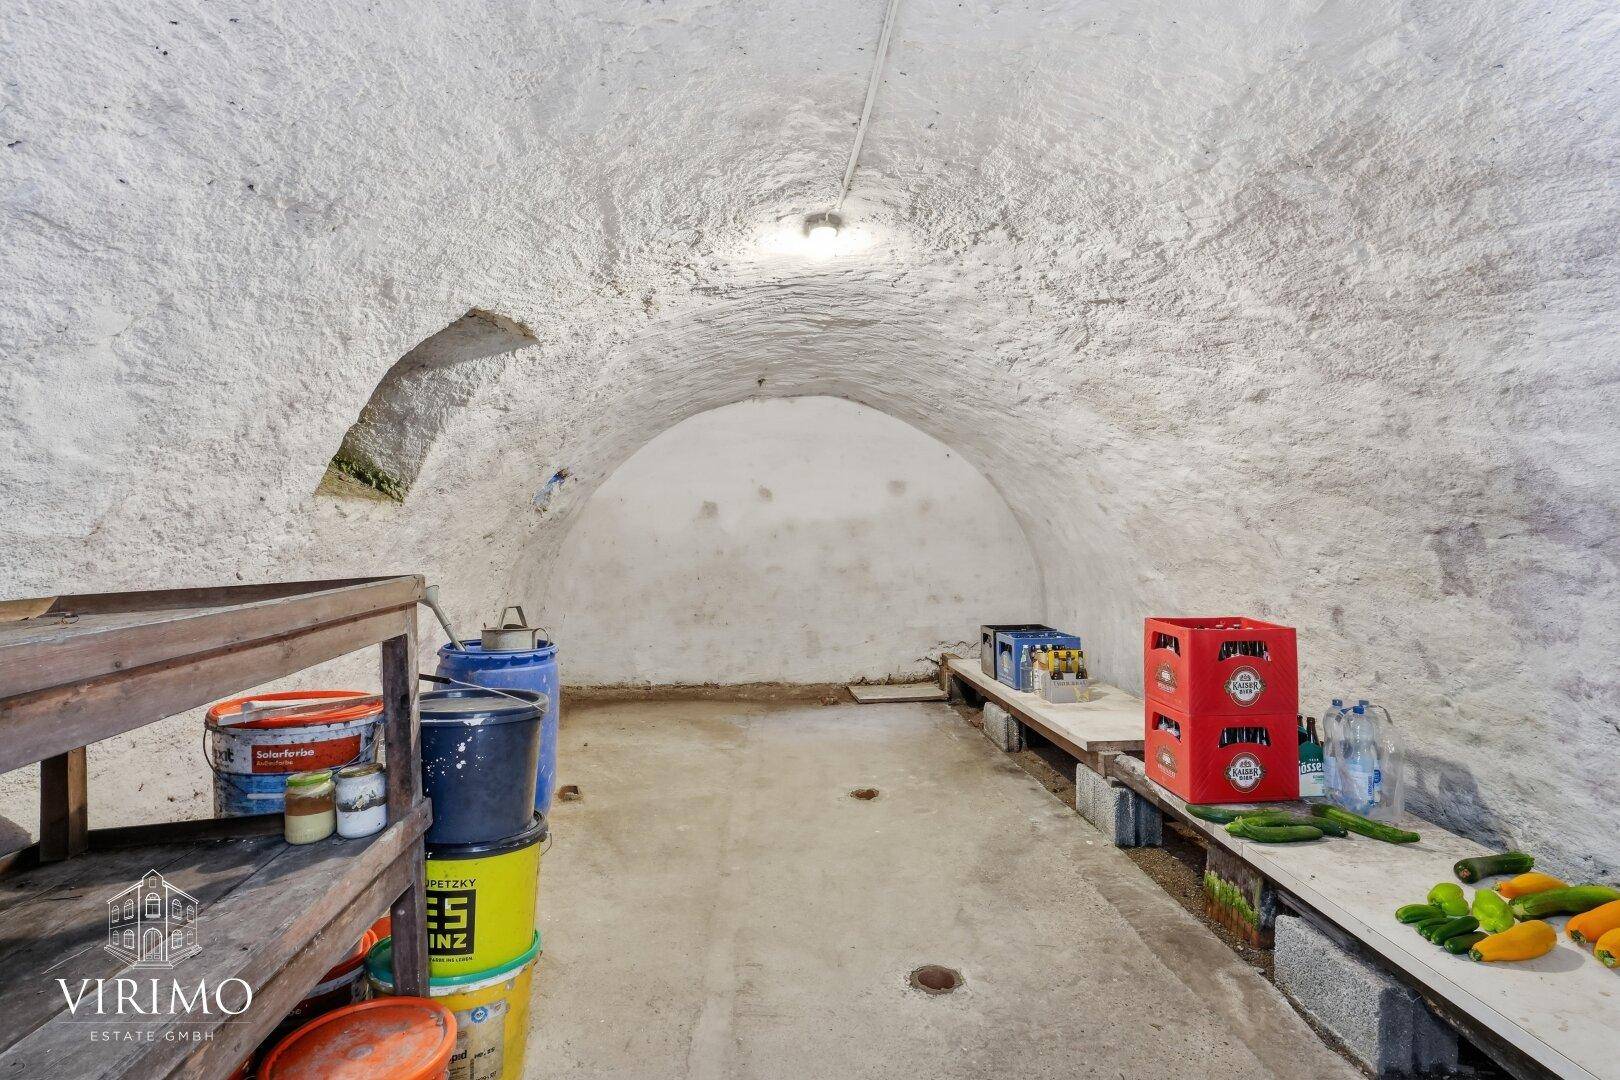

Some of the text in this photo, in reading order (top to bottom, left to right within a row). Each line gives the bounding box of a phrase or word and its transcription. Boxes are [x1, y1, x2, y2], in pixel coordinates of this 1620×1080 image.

[1232, 681, 1259, 691] KAISER
[256, 748, 315, 759] Solarfarbe
[1232, 767, 1259, 777] KAISER
[1301, 761, 1323, 774] össe
